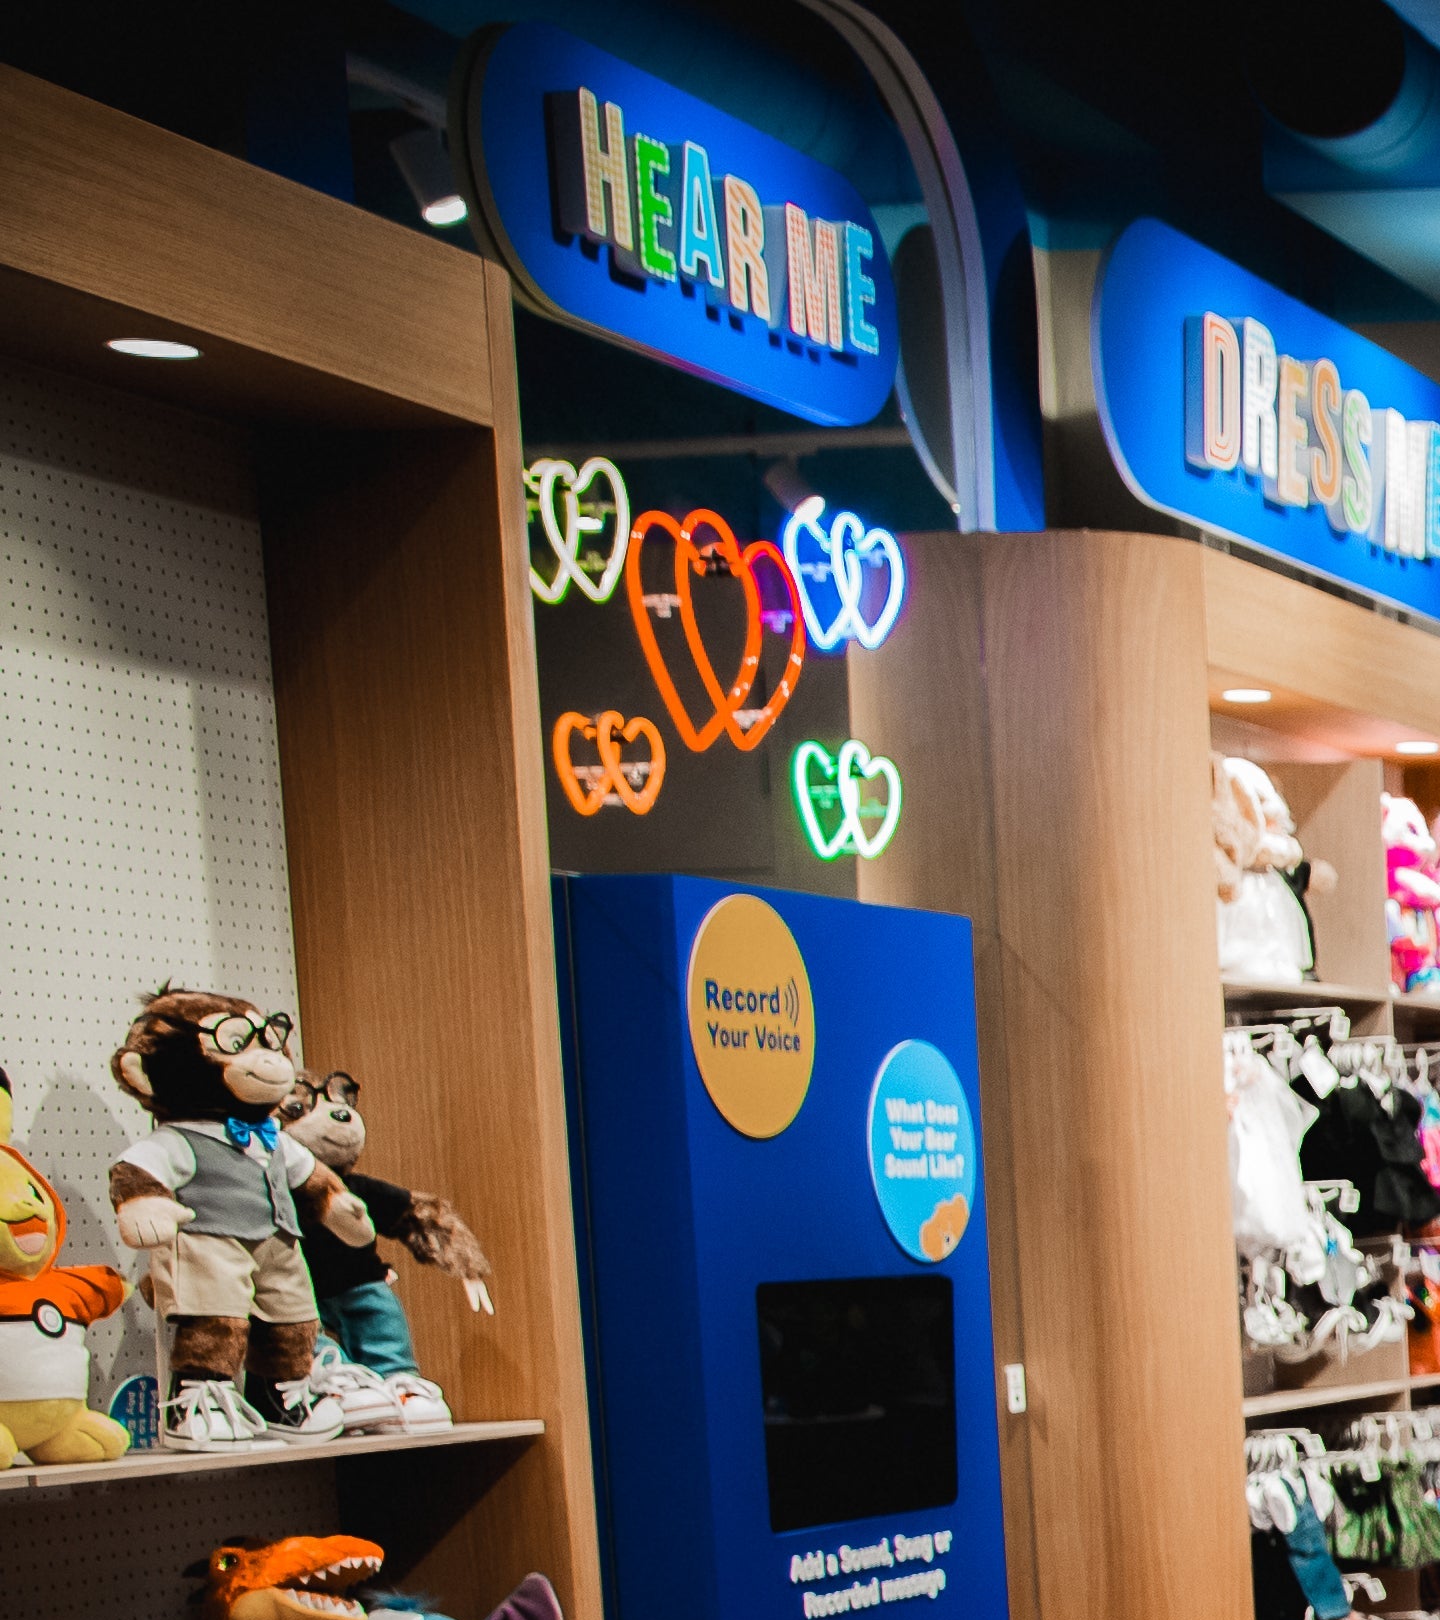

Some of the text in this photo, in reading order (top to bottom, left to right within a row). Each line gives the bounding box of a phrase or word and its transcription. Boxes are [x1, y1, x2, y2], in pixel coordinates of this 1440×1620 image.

[578, 86, 881, 356] HEAR ME
[1201, 311, 1372, 537] DRESS
[704, 979, 780, 1015] Record
[707, 1022, 800, 1052] Your Voice
[885, 1097, 959, 1126] What Does
[889, 1126, 957, 1151] Your Bear
[885, 1153, 964, 1179] Sound Like?
[790, 1530, 952, 1584] Add a Sound, Song or
[803, 1568, 946, 1620] Recorded message
